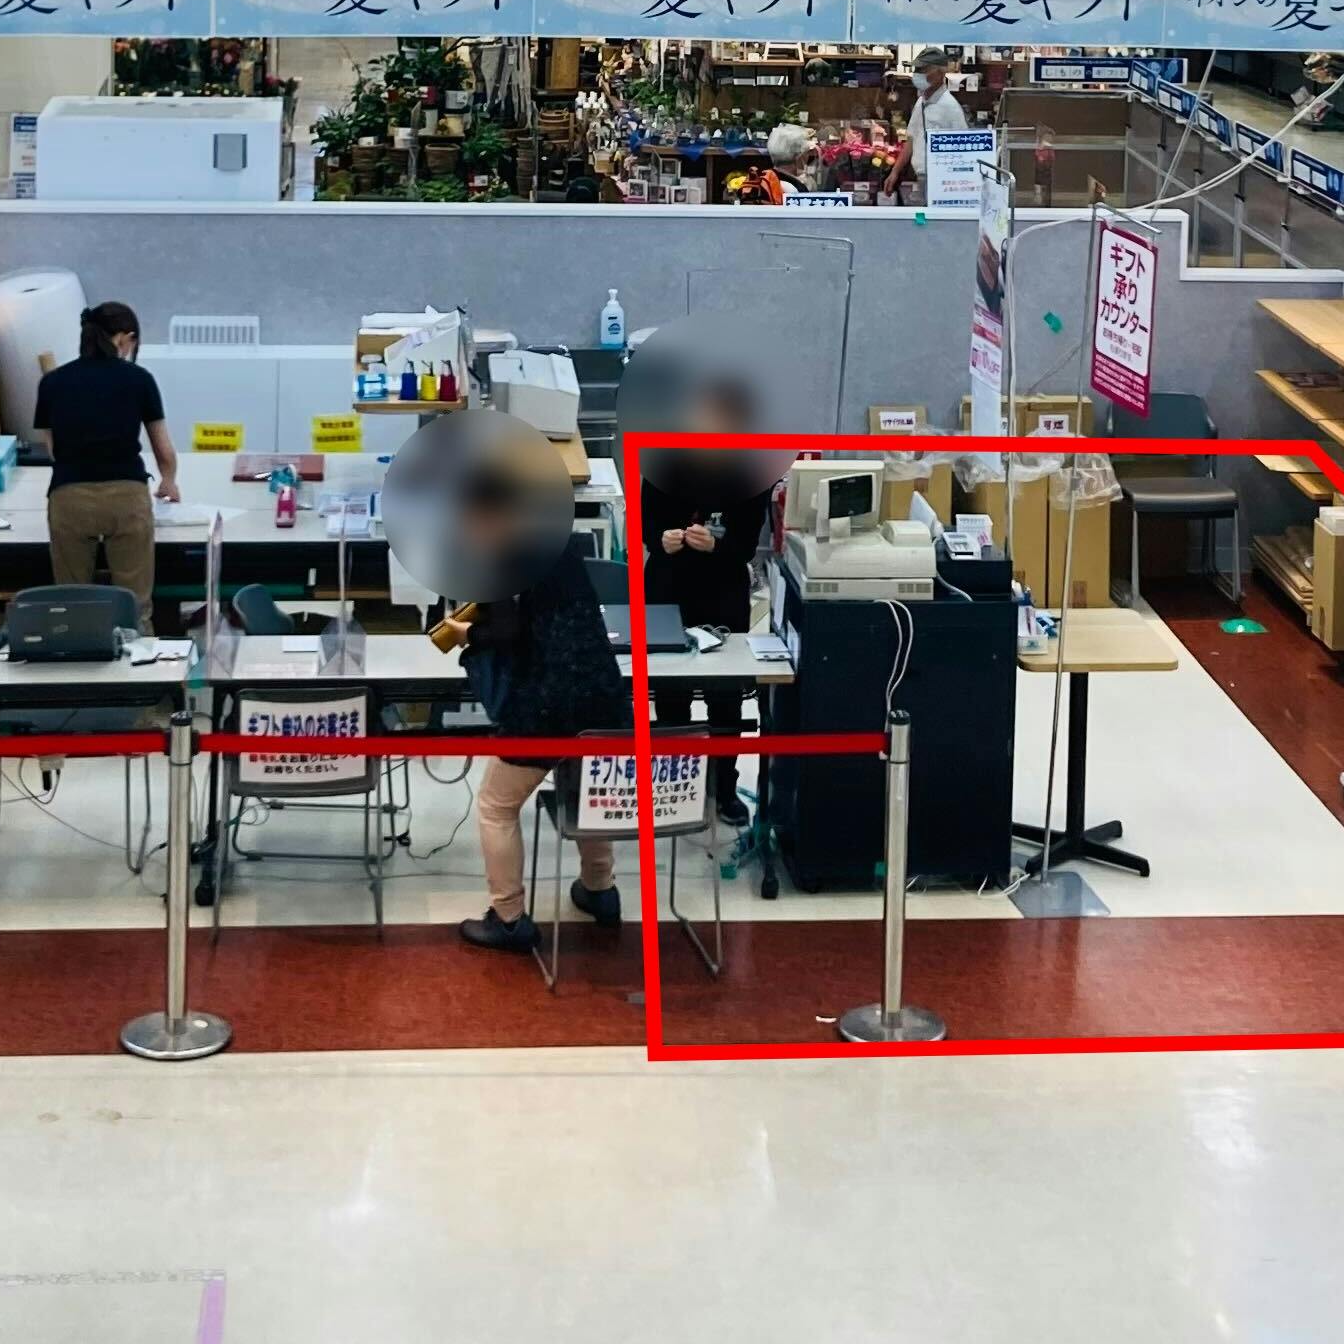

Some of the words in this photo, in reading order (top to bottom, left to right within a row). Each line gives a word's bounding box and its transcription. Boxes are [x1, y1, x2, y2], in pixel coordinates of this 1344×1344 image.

[1110, 241, 1145, 278] ギフト
[1113, 271, 1138, 305] 承り
[1100, 297, 1149, 335] カウンター
[590, 755, 700, 785] ギフト申のお客さま
